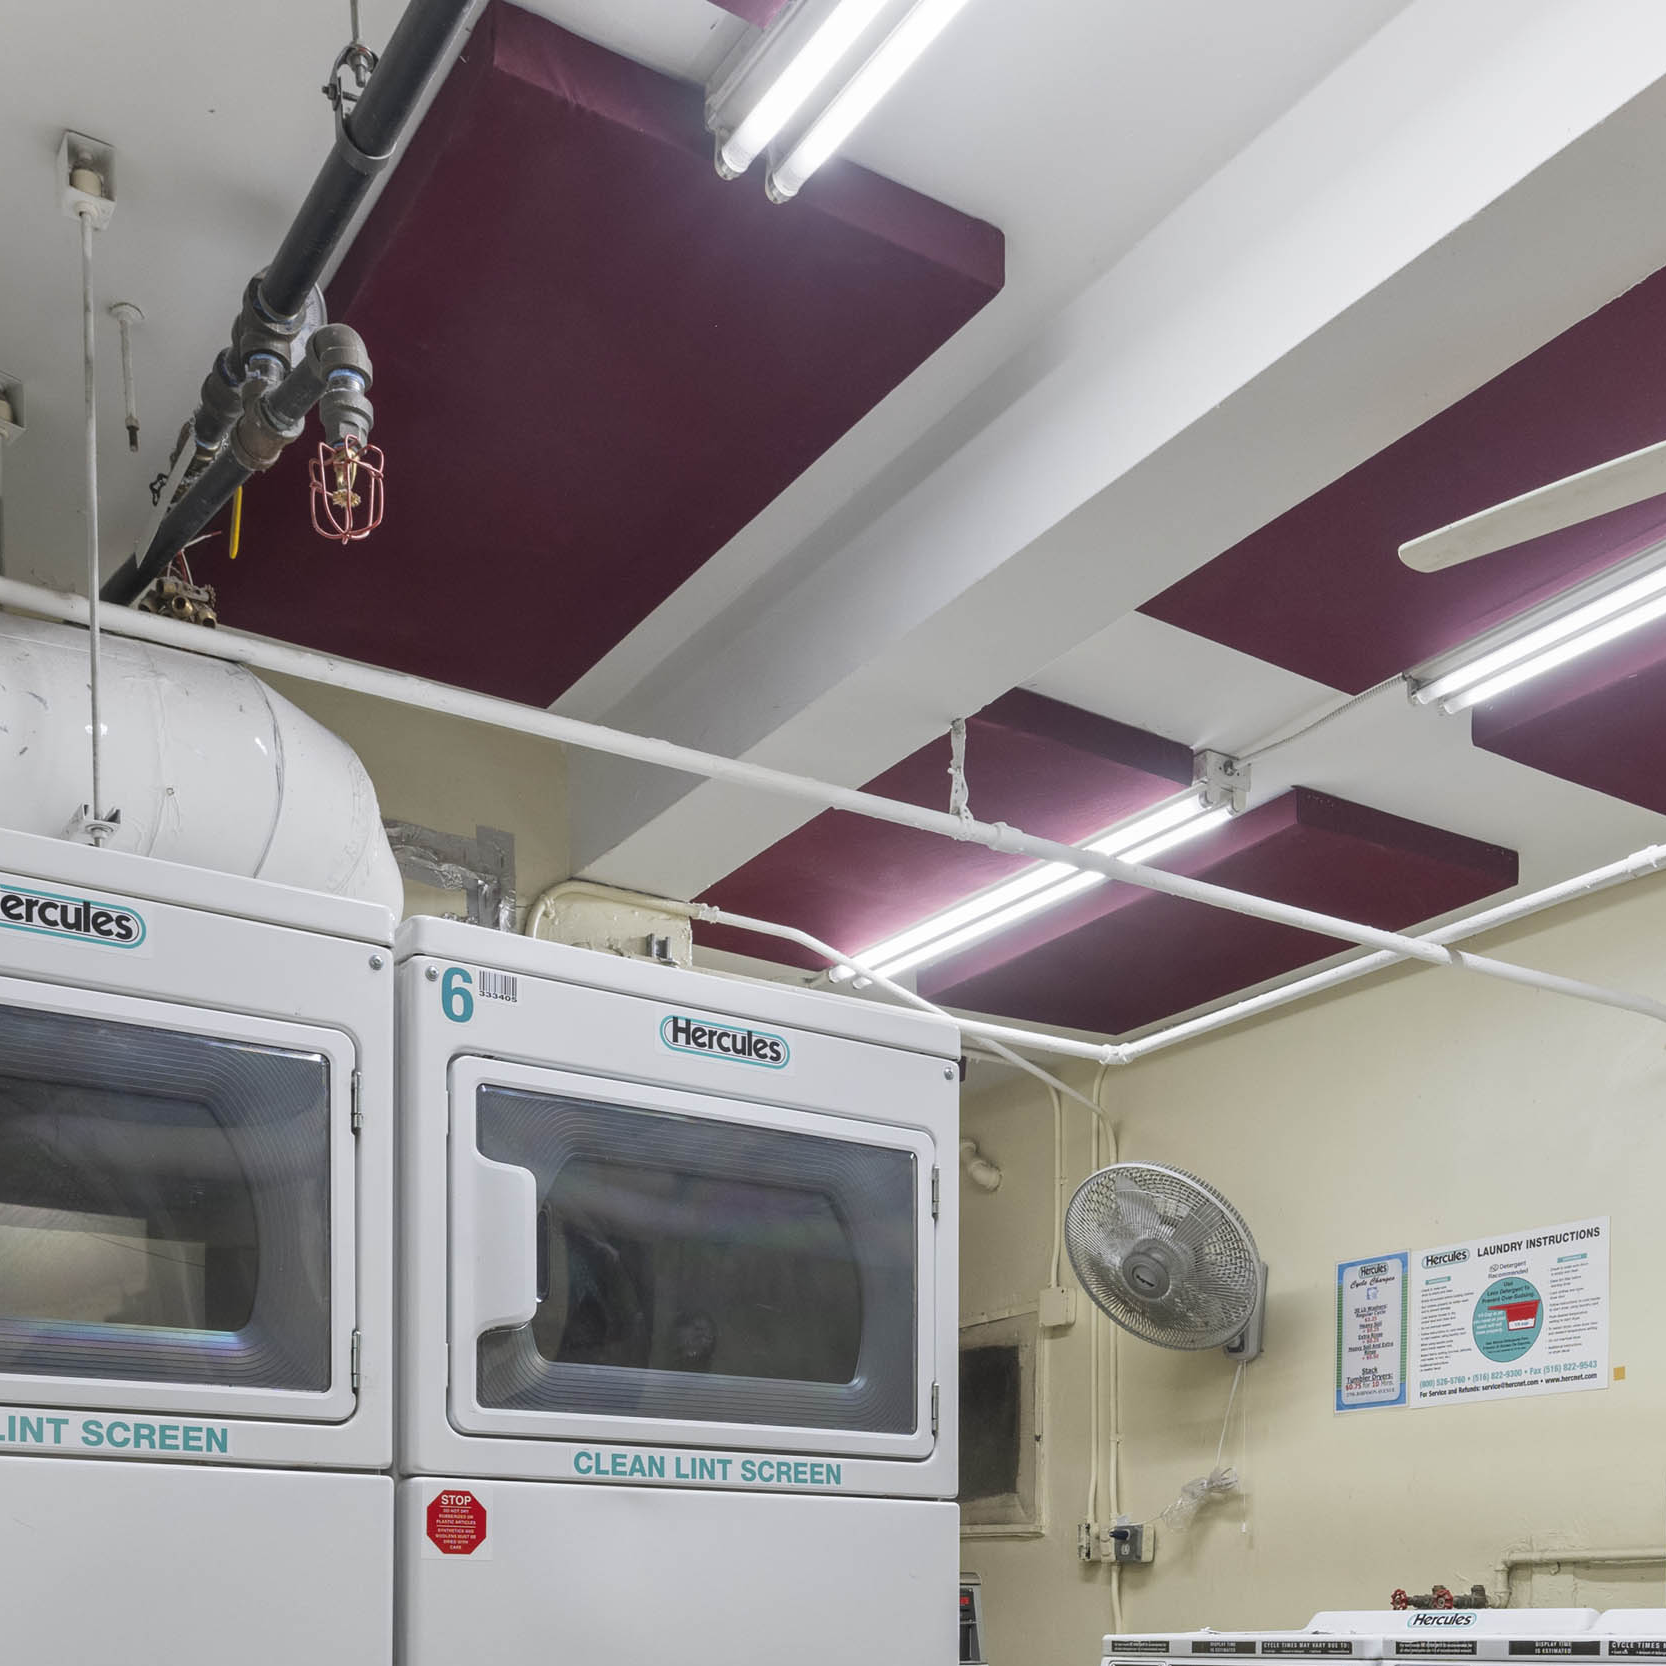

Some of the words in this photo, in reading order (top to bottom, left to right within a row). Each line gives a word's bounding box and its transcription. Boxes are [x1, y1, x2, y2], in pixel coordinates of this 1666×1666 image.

[442, 967, 474, 1023] 6
[673, 1016, 781, 1061] Hercules
[1478, 1240, 1523, 1257] LAUNDRY
[1526, 1227, 1600, 1249] INSTRUCTIONS
[1361, 1264, 1387, 1276] Hercules
[1426, 1251, 1467, 1266] Hercules
[1500, 1261, 1526, 1270] Detergent
[1429, 1387, 1447, 1397] Service
[1459, 1385, 1481, 1394] Refunds:
[1545, 1372, 1597, 1384] www.hercnet.com
[81, 1420, 228, 1453] SCREEN
[574, 1451, 664, 1478] CLEAN
[675, 1457, 732, 1480] LINT
[741, 1460, 841, 1484] SCREEN
[441, 1495, 471, 1505] STOP
[1413, 1613, 1472, 1625] Hercules
